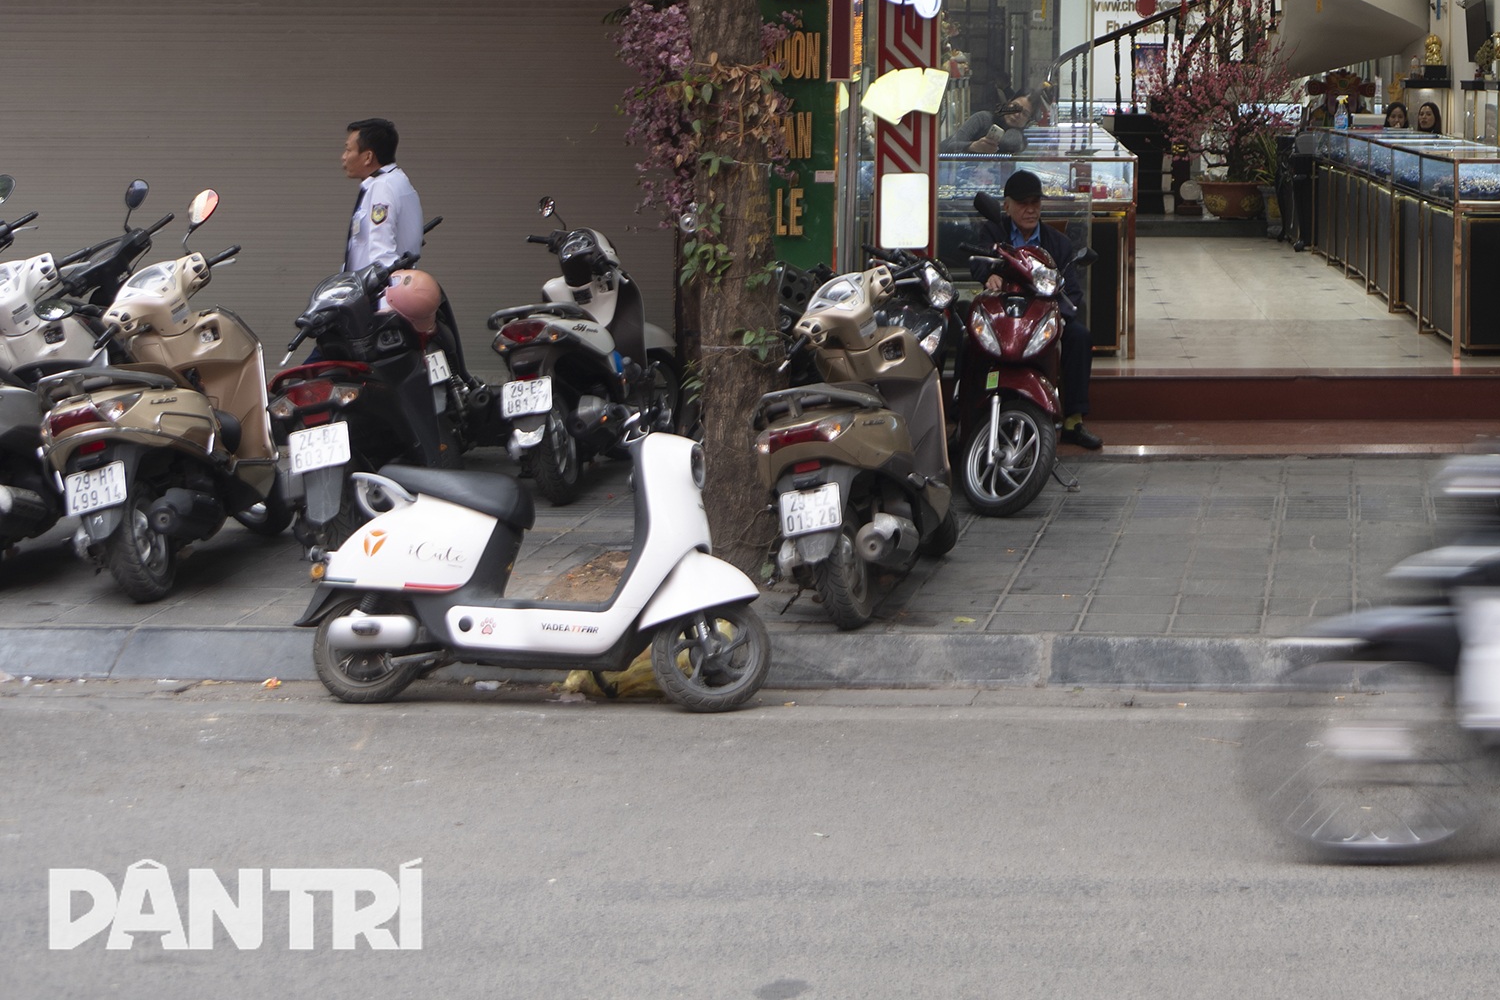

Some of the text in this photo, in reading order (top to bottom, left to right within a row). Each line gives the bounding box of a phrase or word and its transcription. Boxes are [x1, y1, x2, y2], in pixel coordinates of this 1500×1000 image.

[75, 467, 114, 493] 29-H1
[72, 486, 122, 511] 499.14
[786, 507, 837, 532] 015.26
